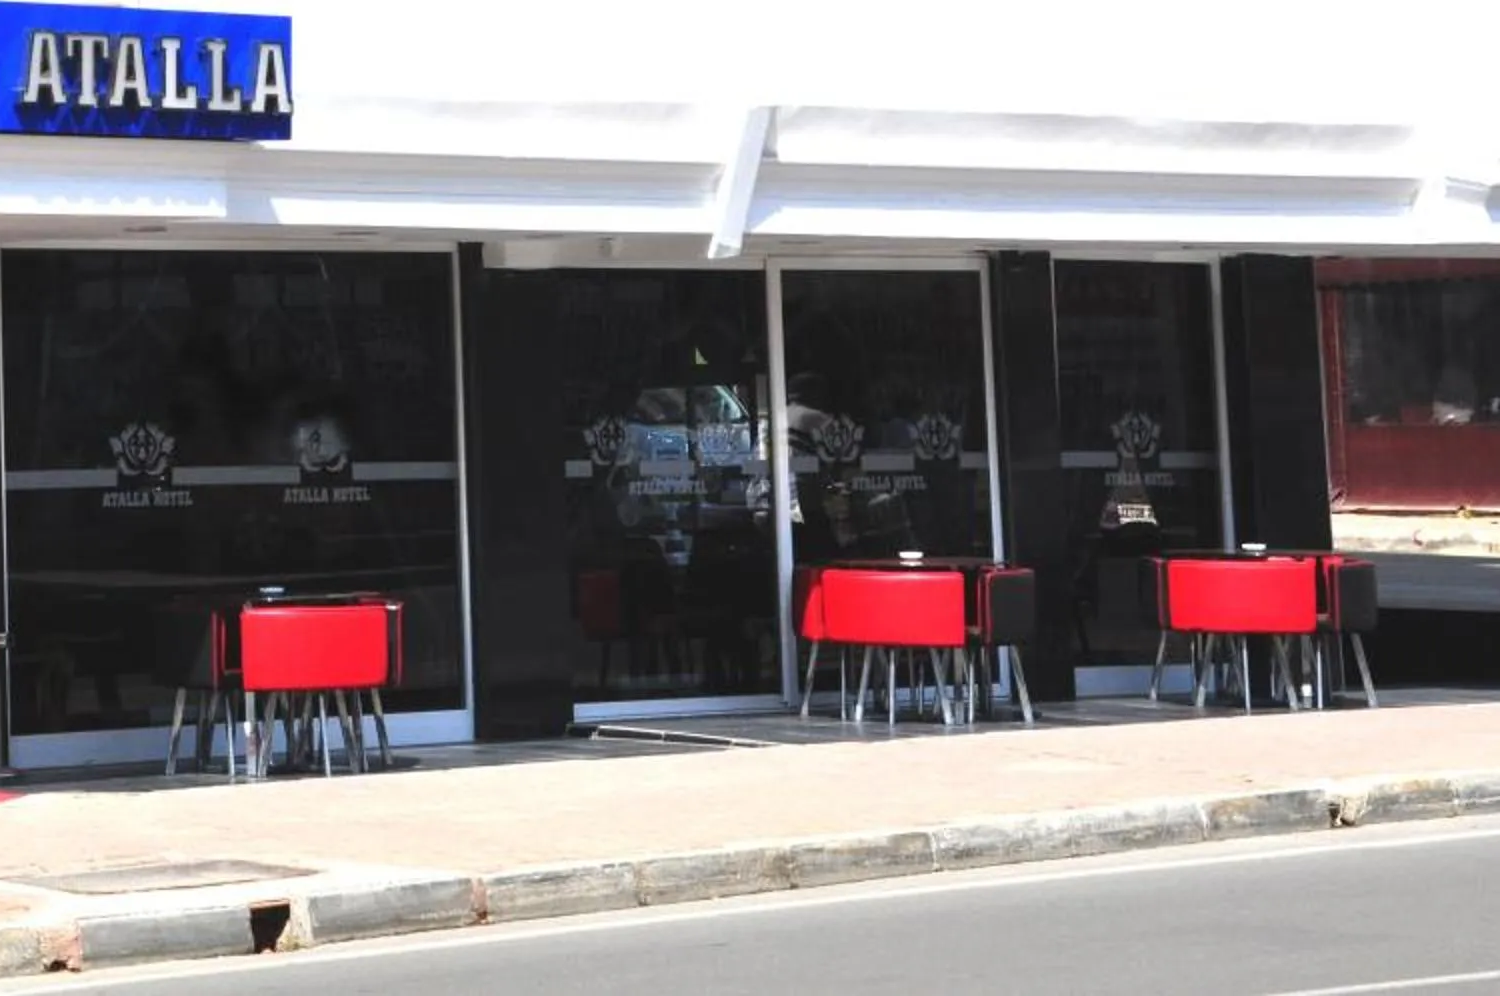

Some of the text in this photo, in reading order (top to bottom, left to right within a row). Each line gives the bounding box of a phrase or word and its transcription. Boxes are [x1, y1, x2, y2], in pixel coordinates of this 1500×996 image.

[22, 31, 293, 114] ATALLA
[852, 475, 927, 491] ATALLA HOTEL
[102, 490, 193, 508] ATALLA HOTEL
[283, 486, 371, 503] ATALLA HOTEL
